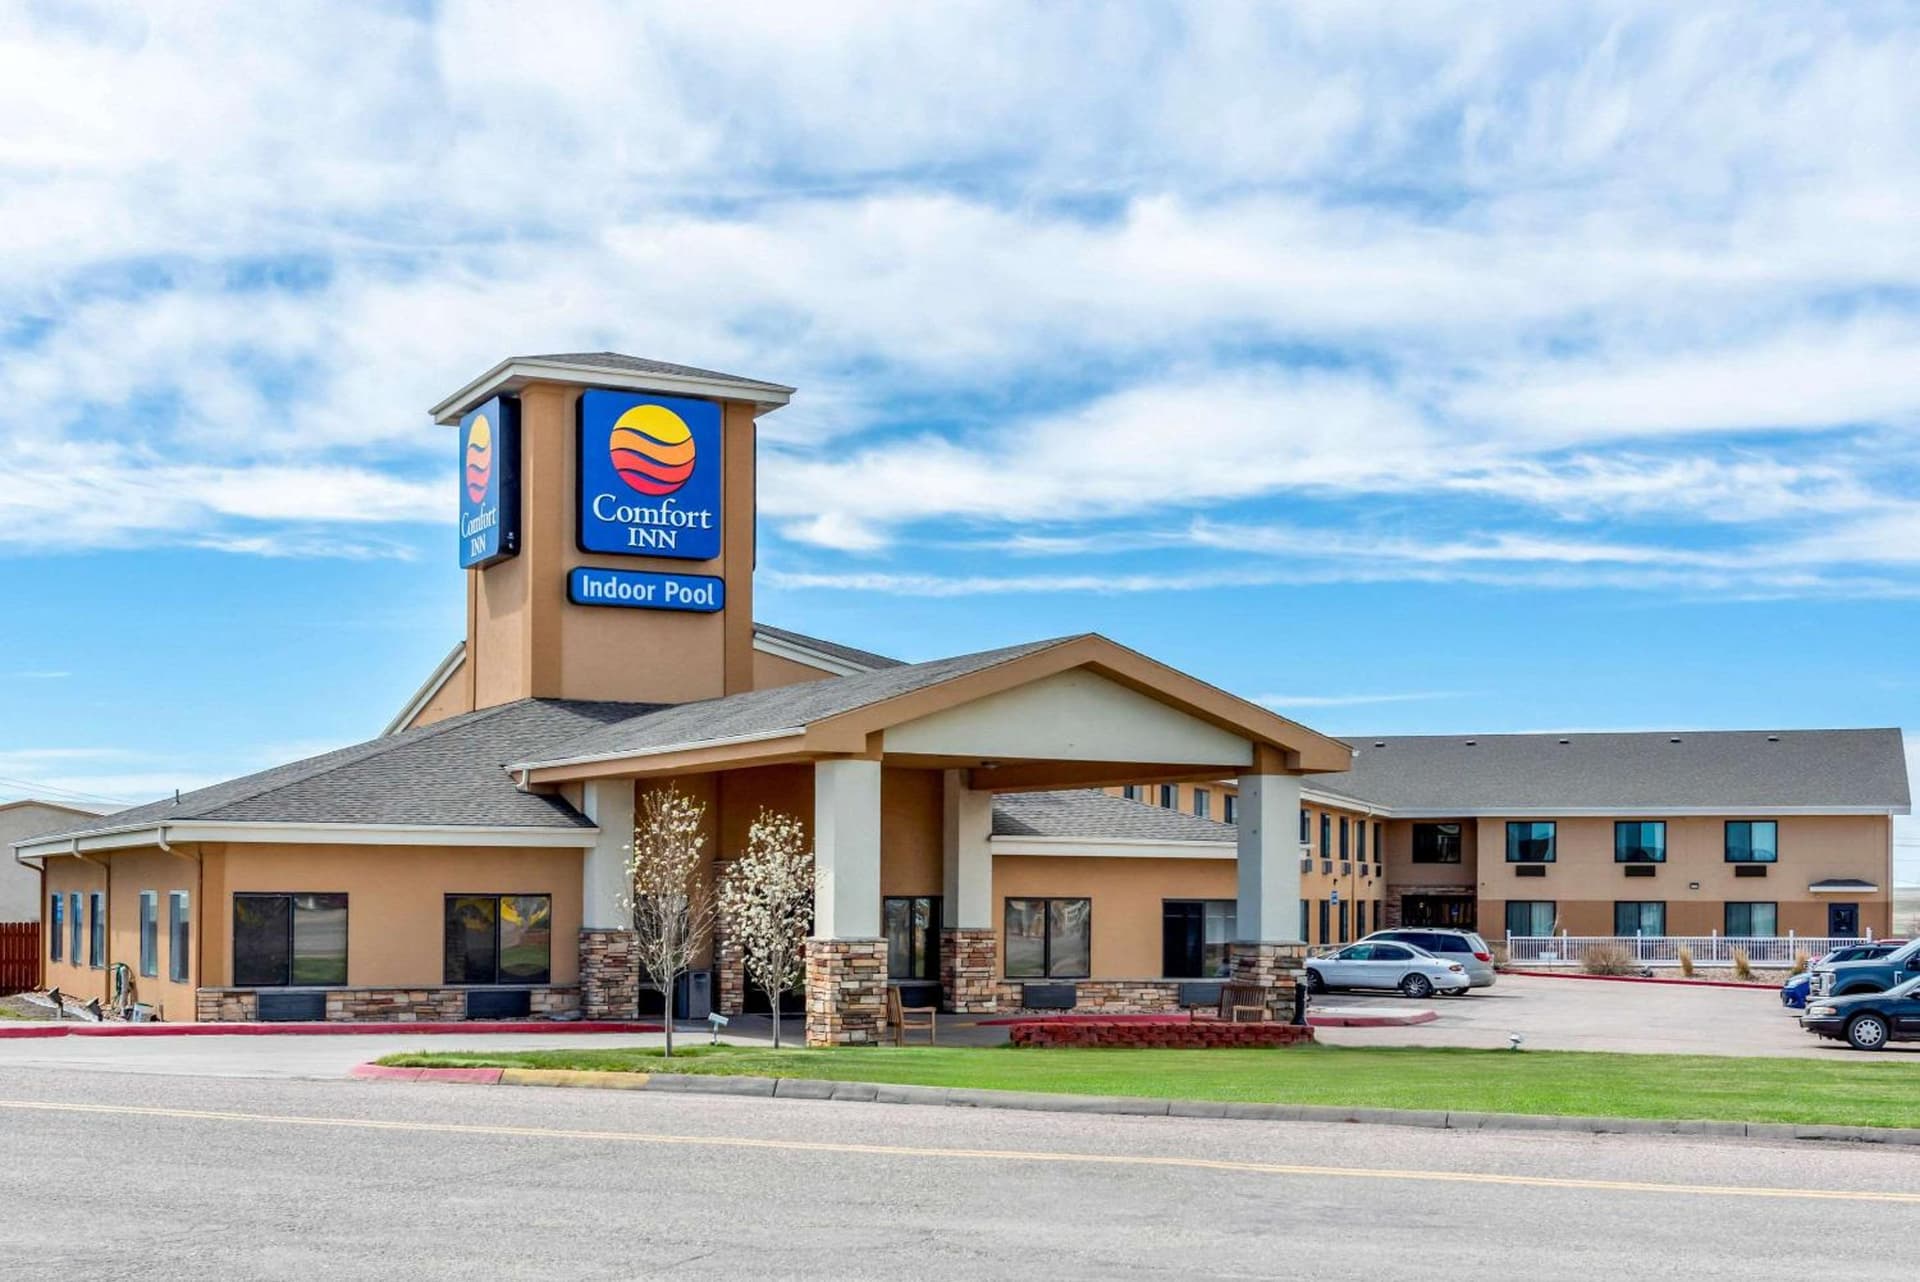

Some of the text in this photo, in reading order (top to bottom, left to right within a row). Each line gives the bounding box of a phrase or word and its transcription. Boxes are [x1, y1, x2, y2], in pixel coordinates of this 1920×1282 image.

[461, 501, 497, 538] Comfort
[592, 493, 713, 530] Comfort
[471, 533, 487, 558] INN
[627, 527, 678, 550] INN
[582, 575, 715, 606] Indoor Pool
